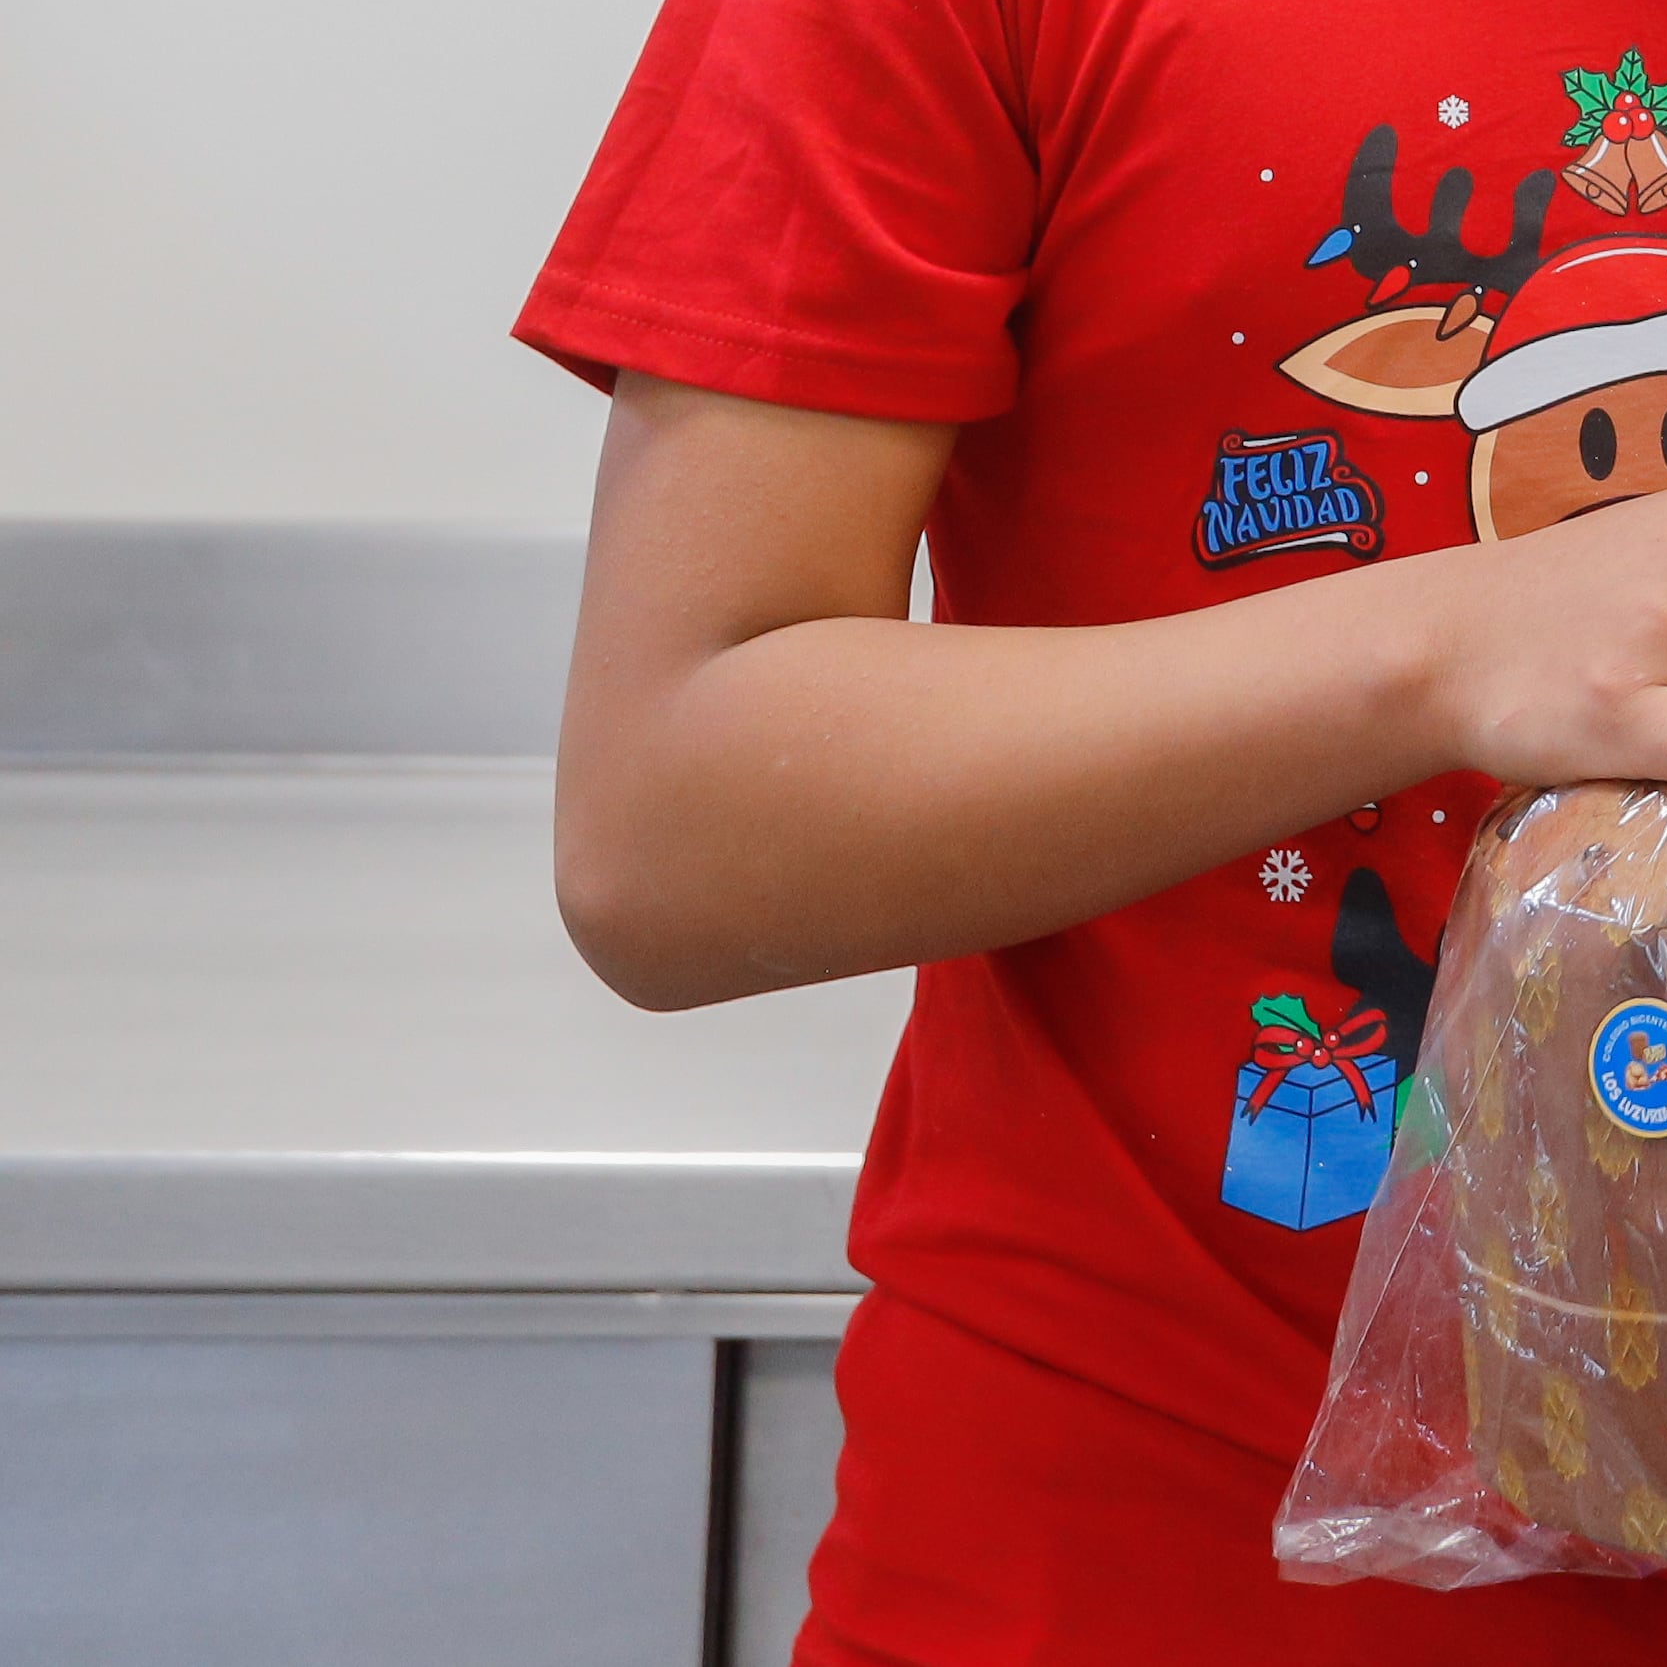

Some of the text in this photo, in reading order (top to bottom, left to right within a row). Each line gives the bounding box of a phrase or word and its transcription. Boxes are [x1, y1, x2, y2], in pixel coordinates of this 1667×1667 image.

[1221, 443, 1331, 505] FELIZ
[1203, 487, 1360, 552] NAVIDAD
[1602, 1019, 1630, 1063] COLEGIO
[1601, 1071, 1622, 1101] LOS
